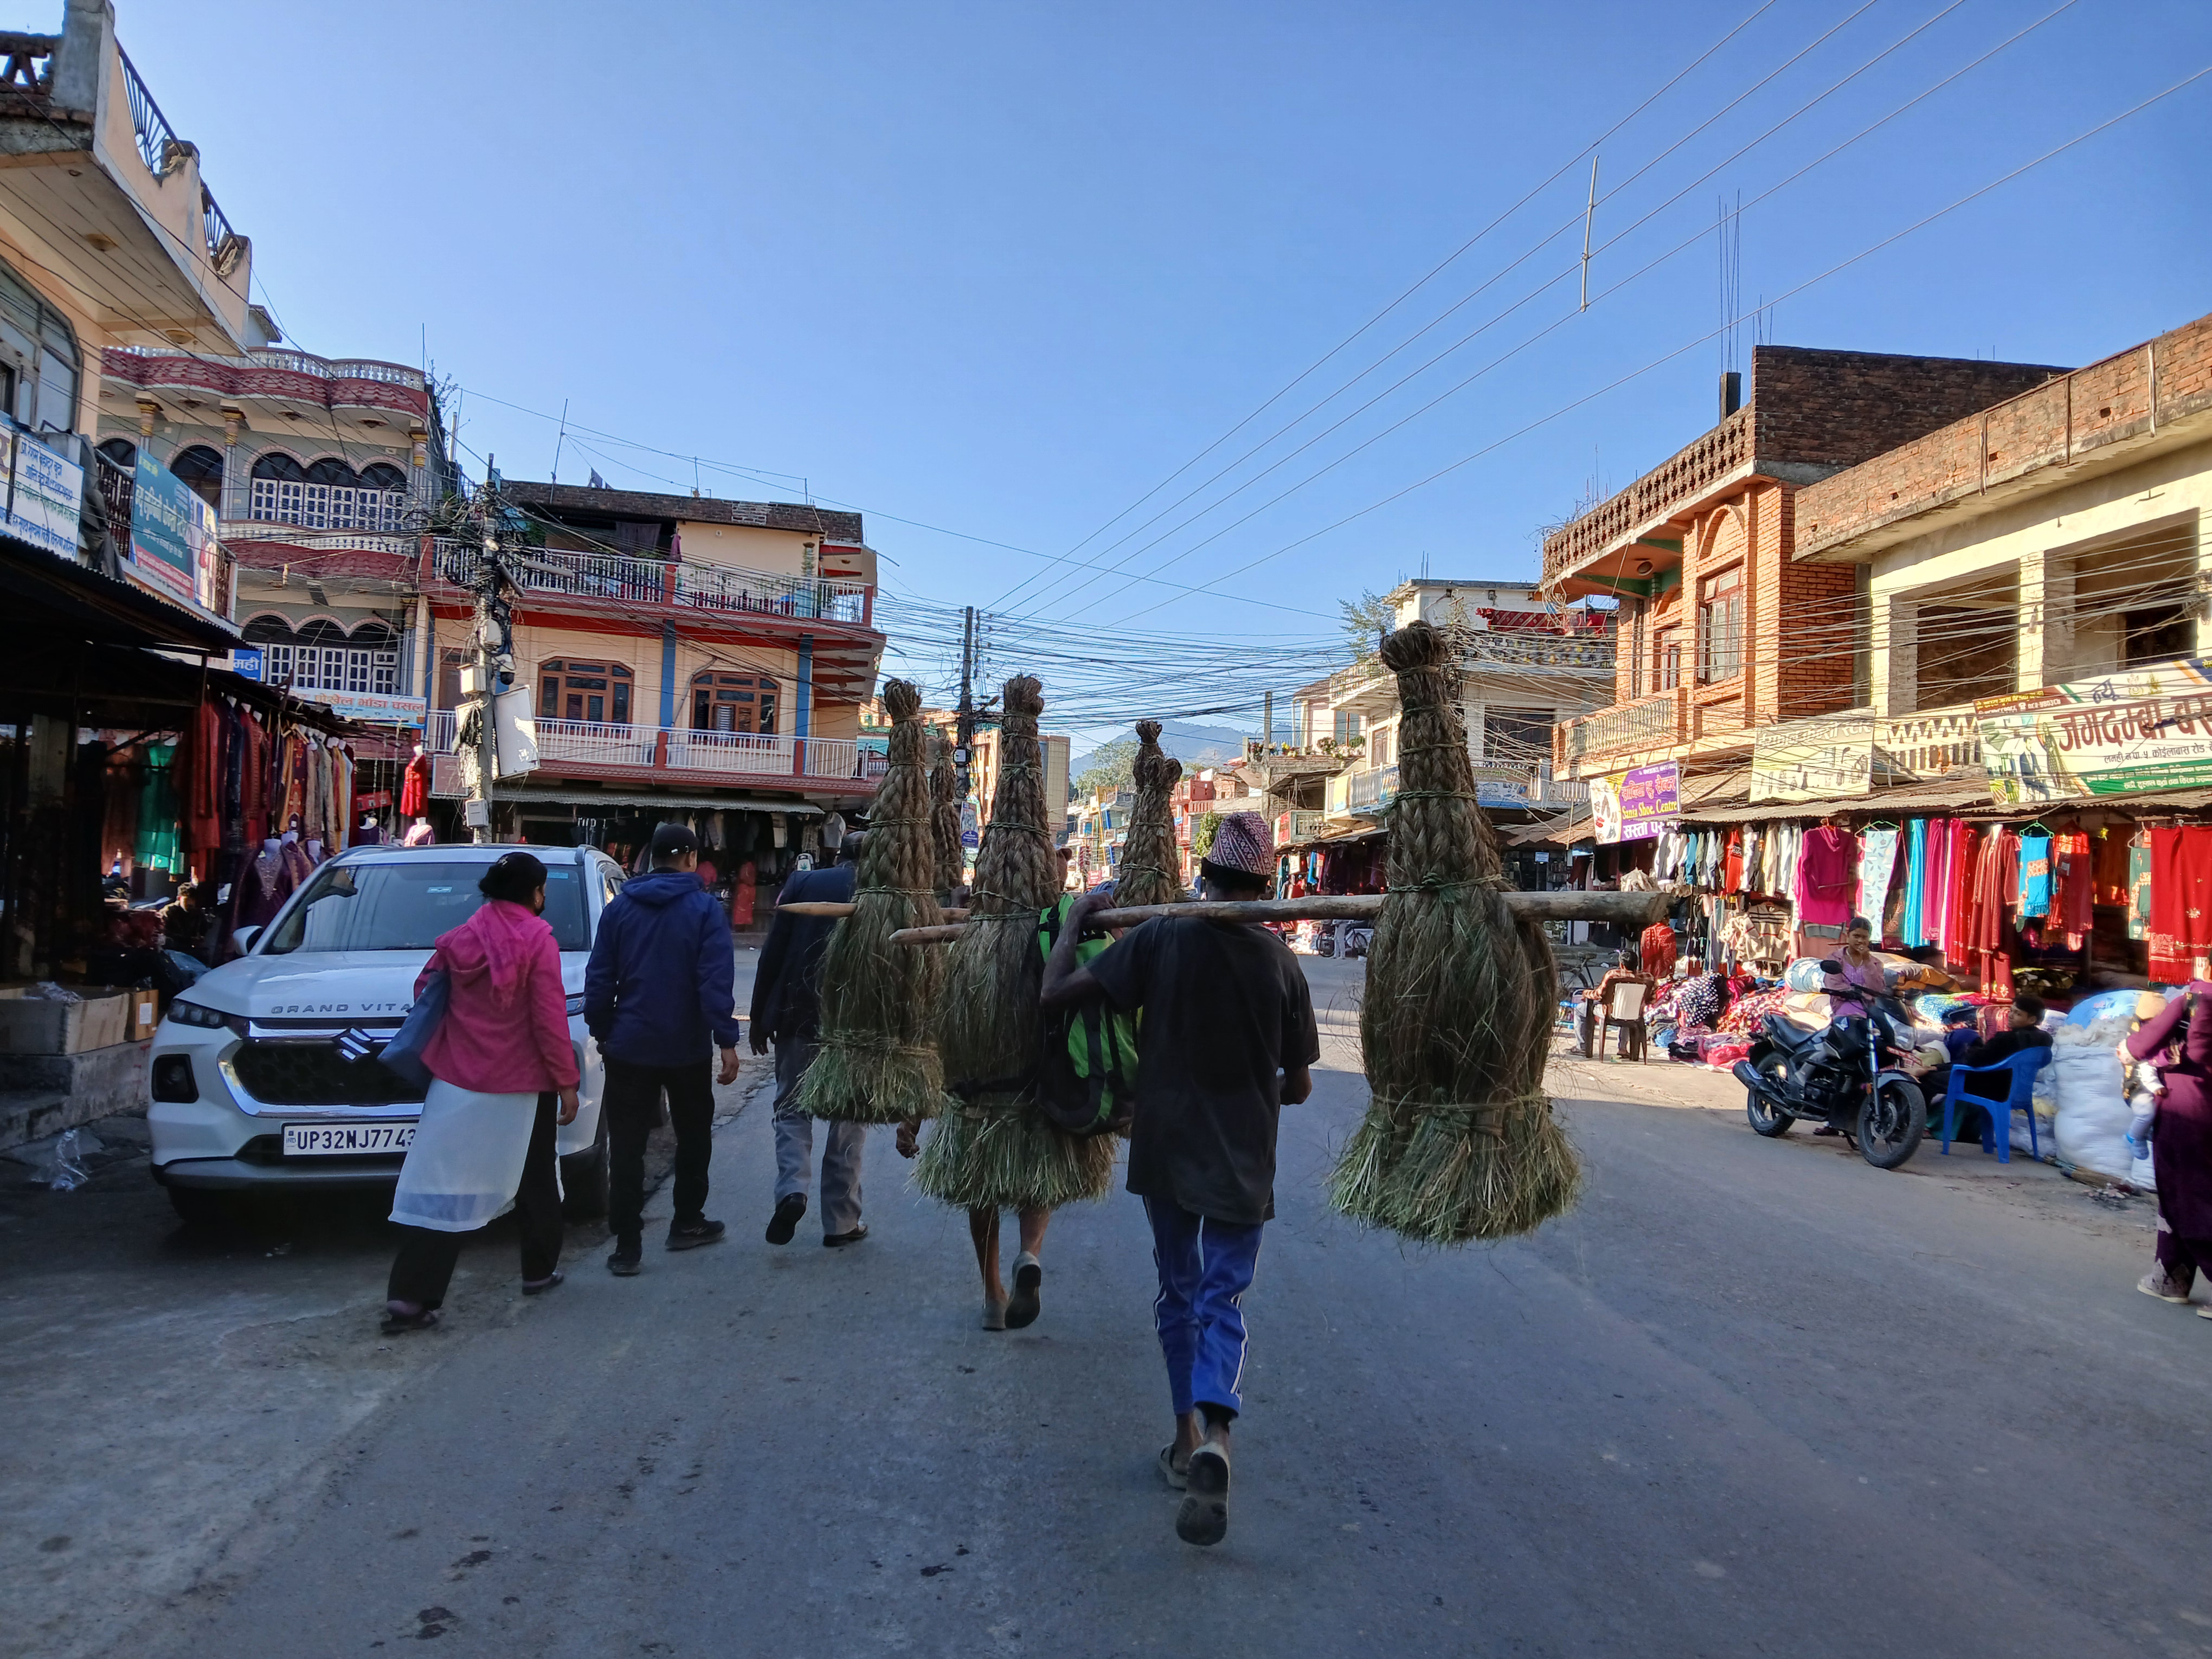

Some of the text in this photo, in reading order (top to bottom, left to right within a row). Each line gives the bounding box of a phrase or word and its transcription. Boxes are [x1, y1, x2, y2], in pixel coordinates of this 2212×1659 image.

[234, 657, 260, 671] मही
[392, 701, 425, 712] पसल
[1622, 805, 1638, 820] Sania
[1656, 799, 1677, 814] Centre
[271, 1003, 411, 1014] GRAND VITA
